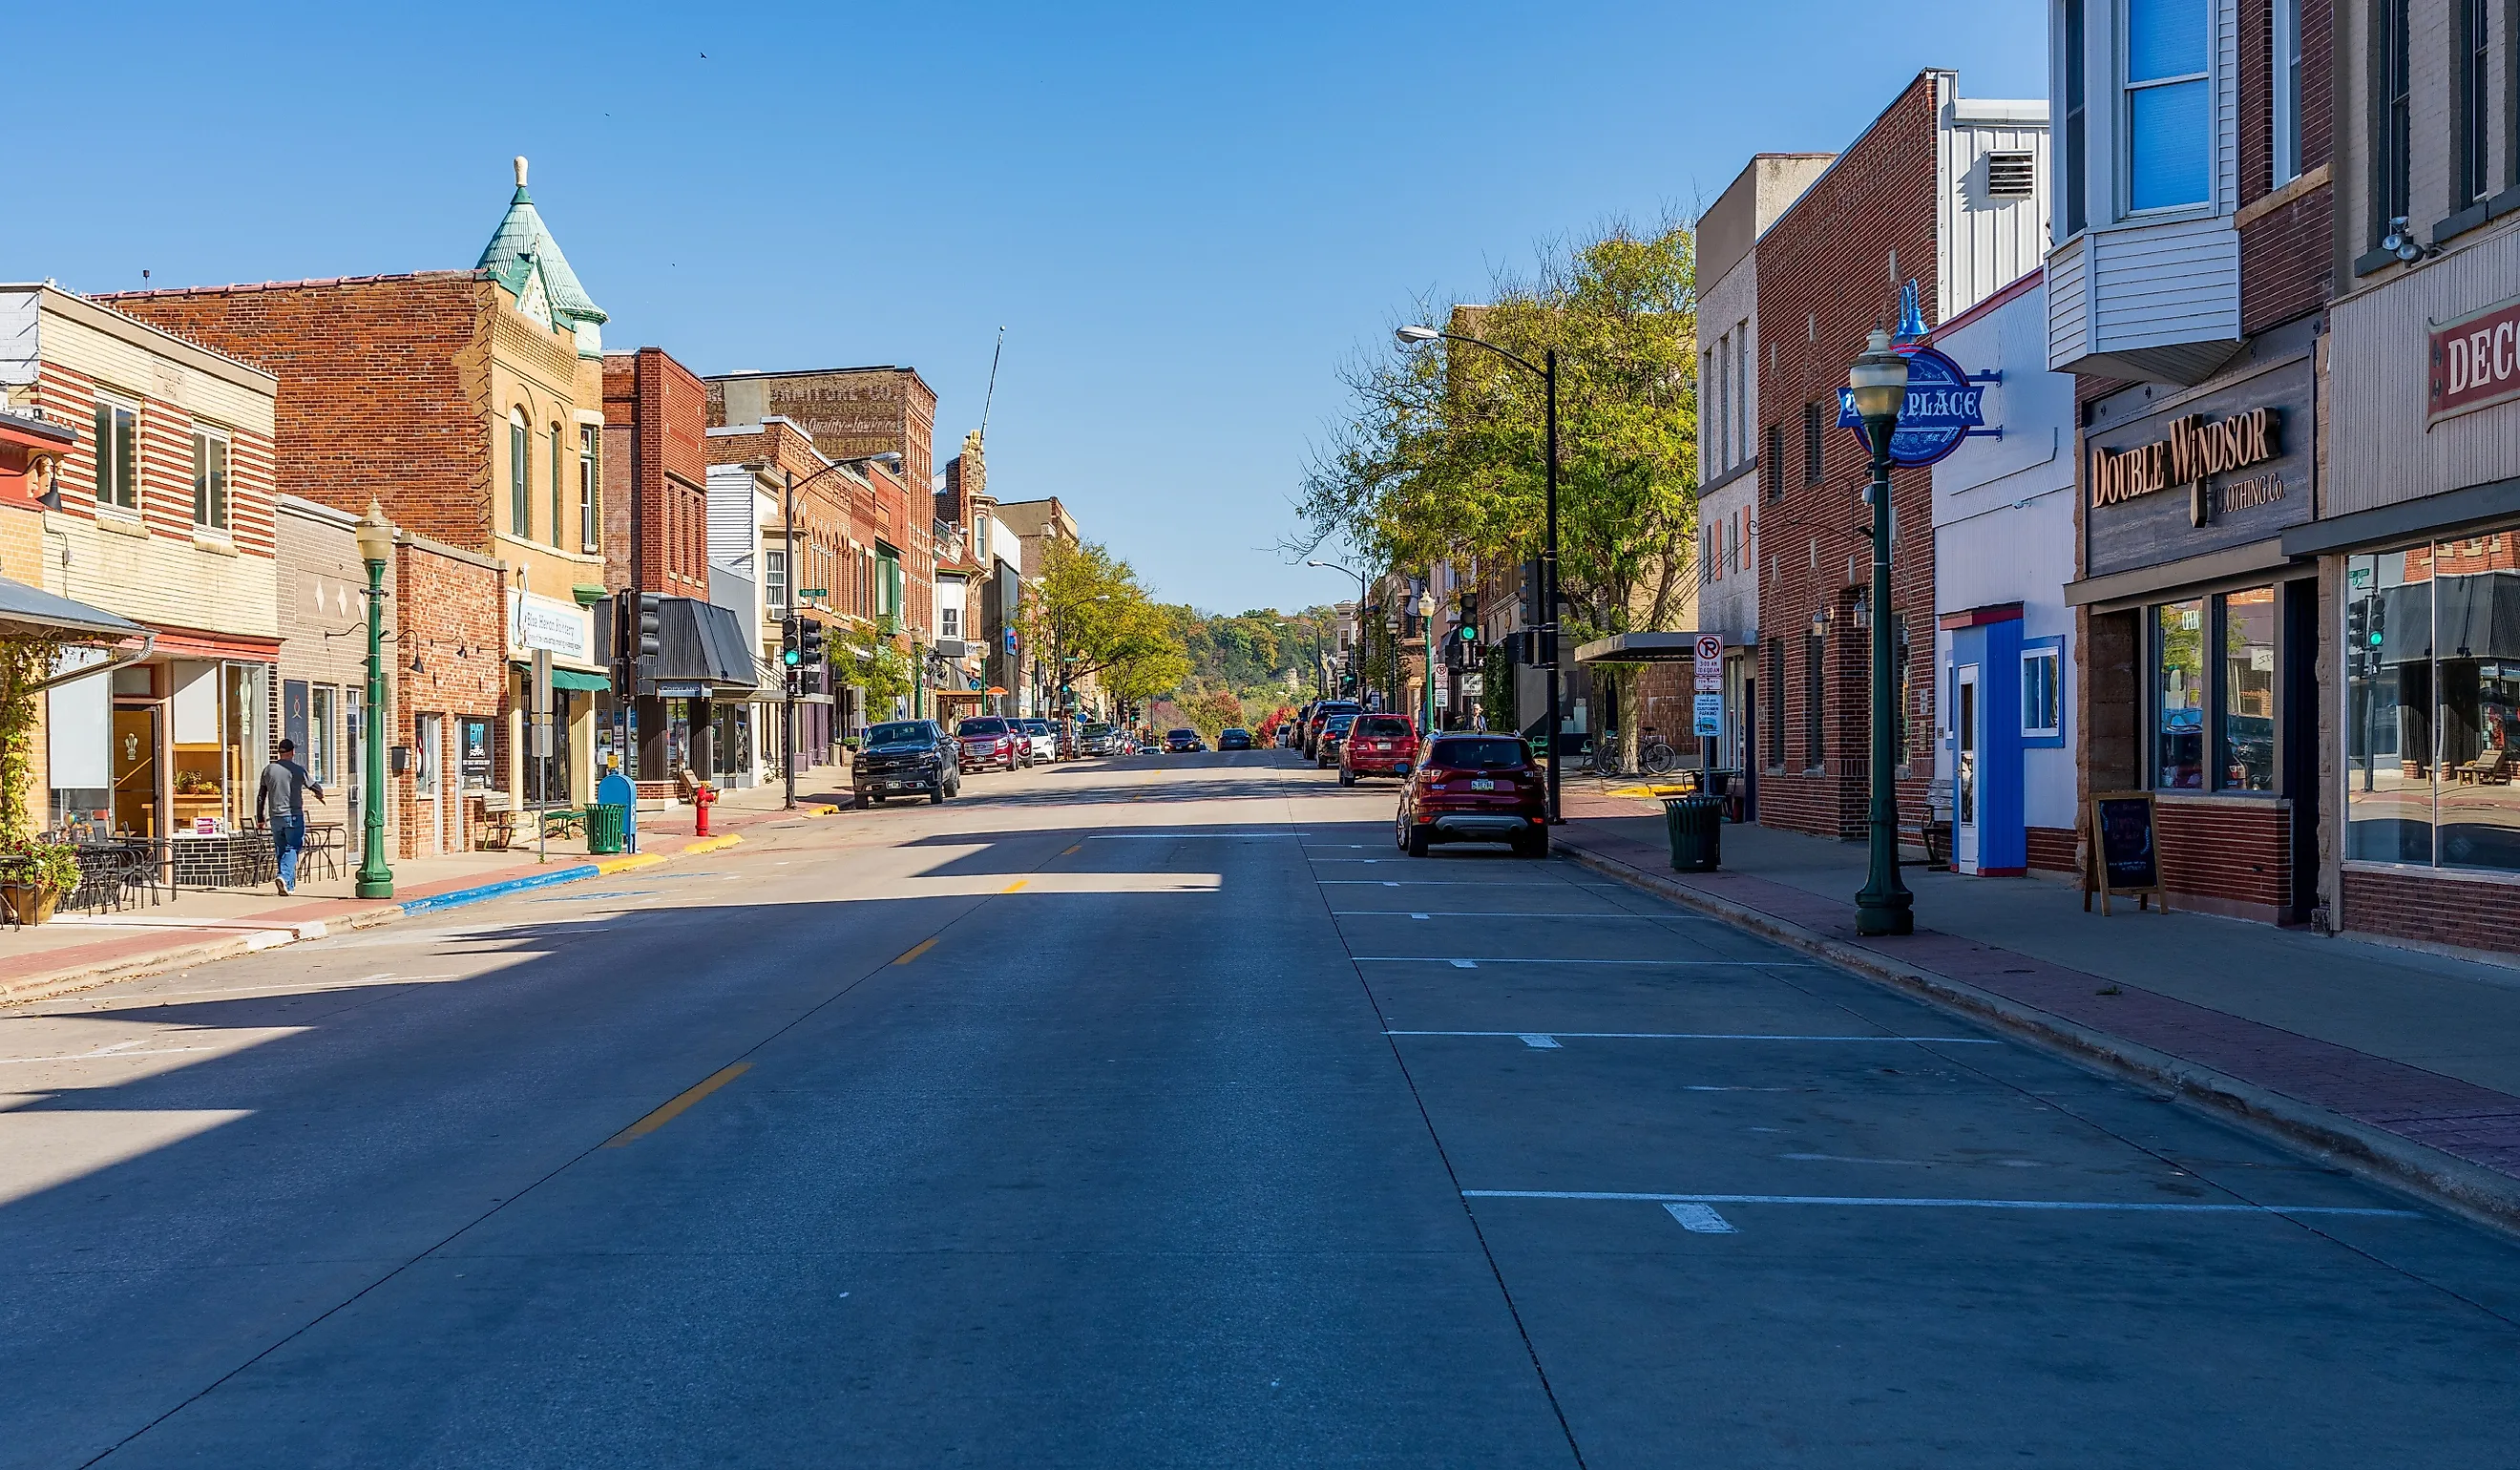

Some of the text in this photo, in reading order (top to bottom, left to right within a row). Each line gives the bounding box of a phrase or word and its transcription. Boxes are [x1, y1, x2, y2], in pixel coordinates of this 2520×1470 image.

[2448, 321, 2520, 395] DEC
[1907, 389, 1979, 419] PLACE
[2091, 440, 2166, 509] DOUBLE
[2215, 475, 2266, 515] CLOTHING
